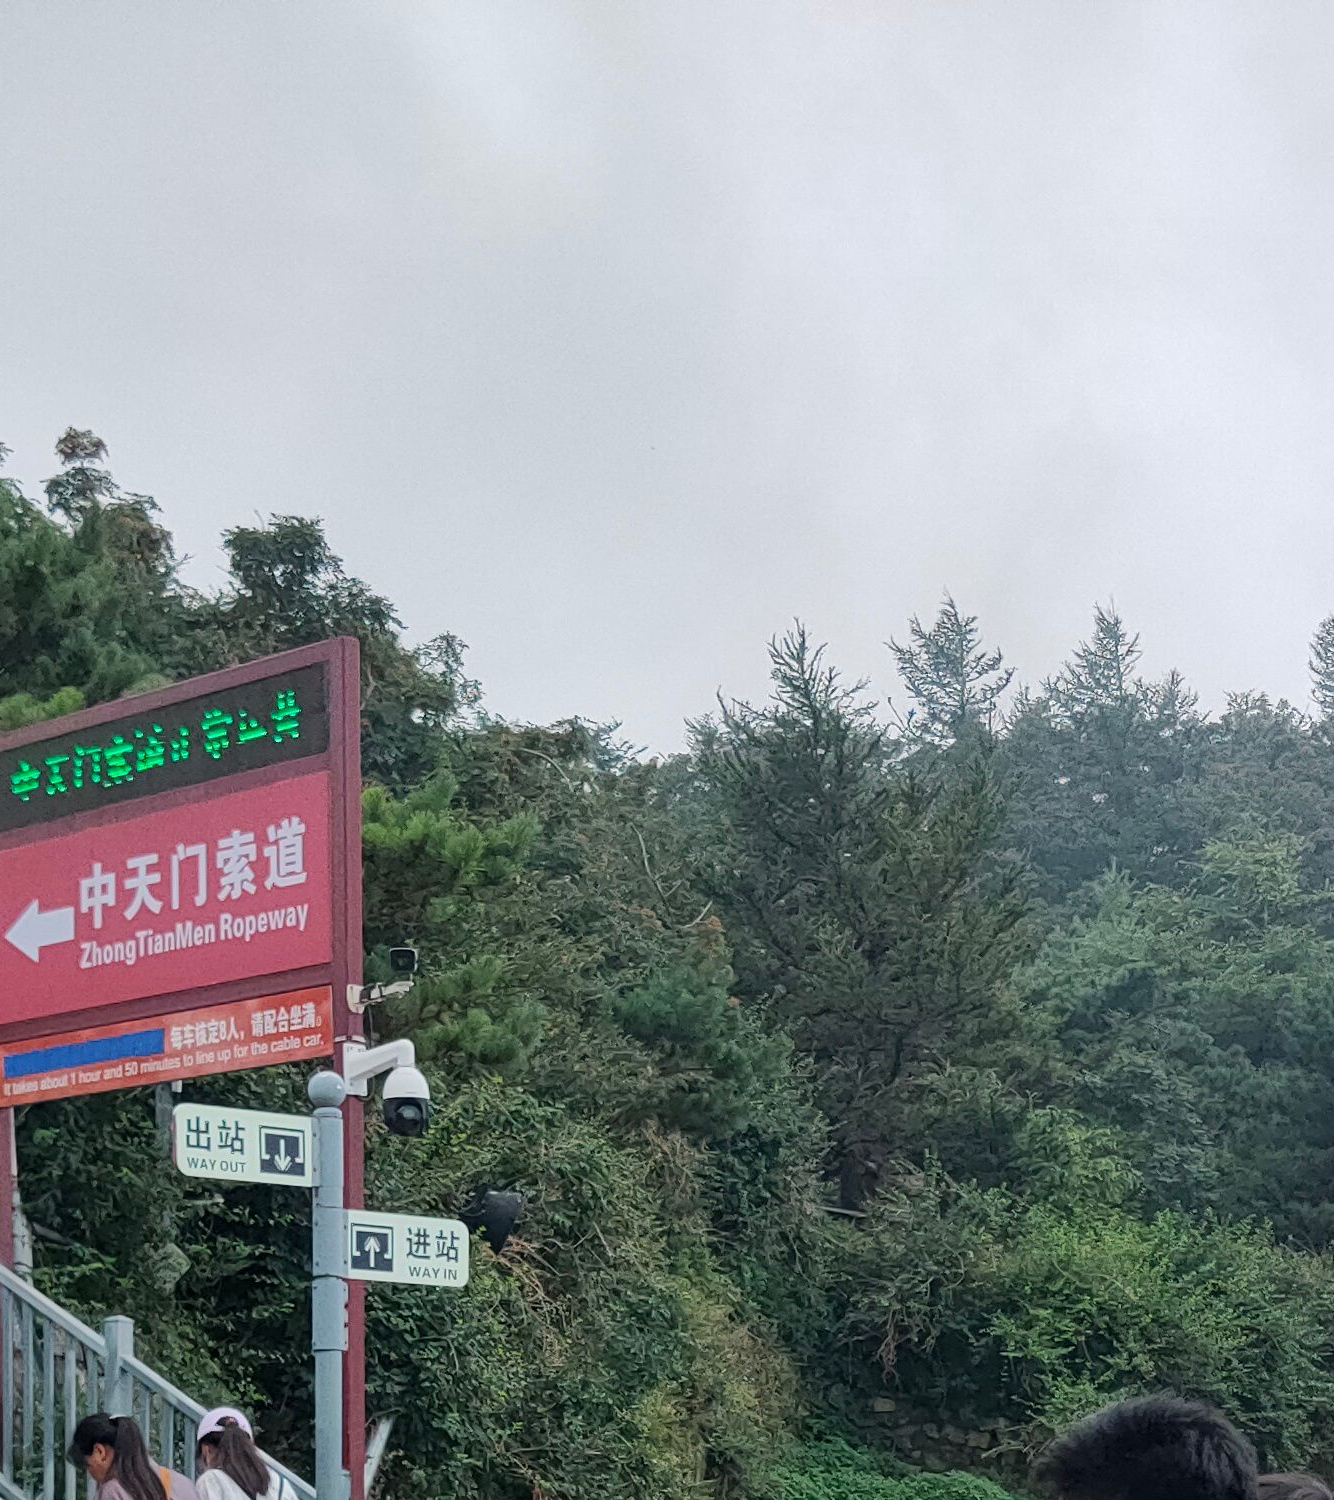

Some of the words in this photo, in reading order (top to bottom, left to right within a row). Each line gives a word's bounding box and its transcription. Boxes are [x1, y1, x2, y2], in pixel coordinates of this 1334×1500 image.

[79, 815, 308, 929] 中天门索道
[79, 920, 216, 969] ZhongTianMen
[219, 904, 309, 942] Ropeway
[40, 1075, 67, 1090] about
[78, 1069, 102, 1083] hour
[103, 1065, 123, 1080] and
[124, 1061, 138, 1076] 50
[140, 1056, 181, 1074] minutes
[183, 1053, 194, 1067] to
[195, 1050, 215, 1065] line
[217, 1050, 232, 1064] up
[234, 1044, 249, 1058] for
[251, 1040, 268, 1056] the
[270, 1035, 301, 1052] cable
[186, 1116, 246, 1155] 出站
[186, 1157, 217, 1171] WAY
[219, 1159, 247, 1174] OUT
[406, 1226, 460, 1264] 进站
[408, 1265, 441, 1279] WAY
[443, 1267, 458, 1281] IN
